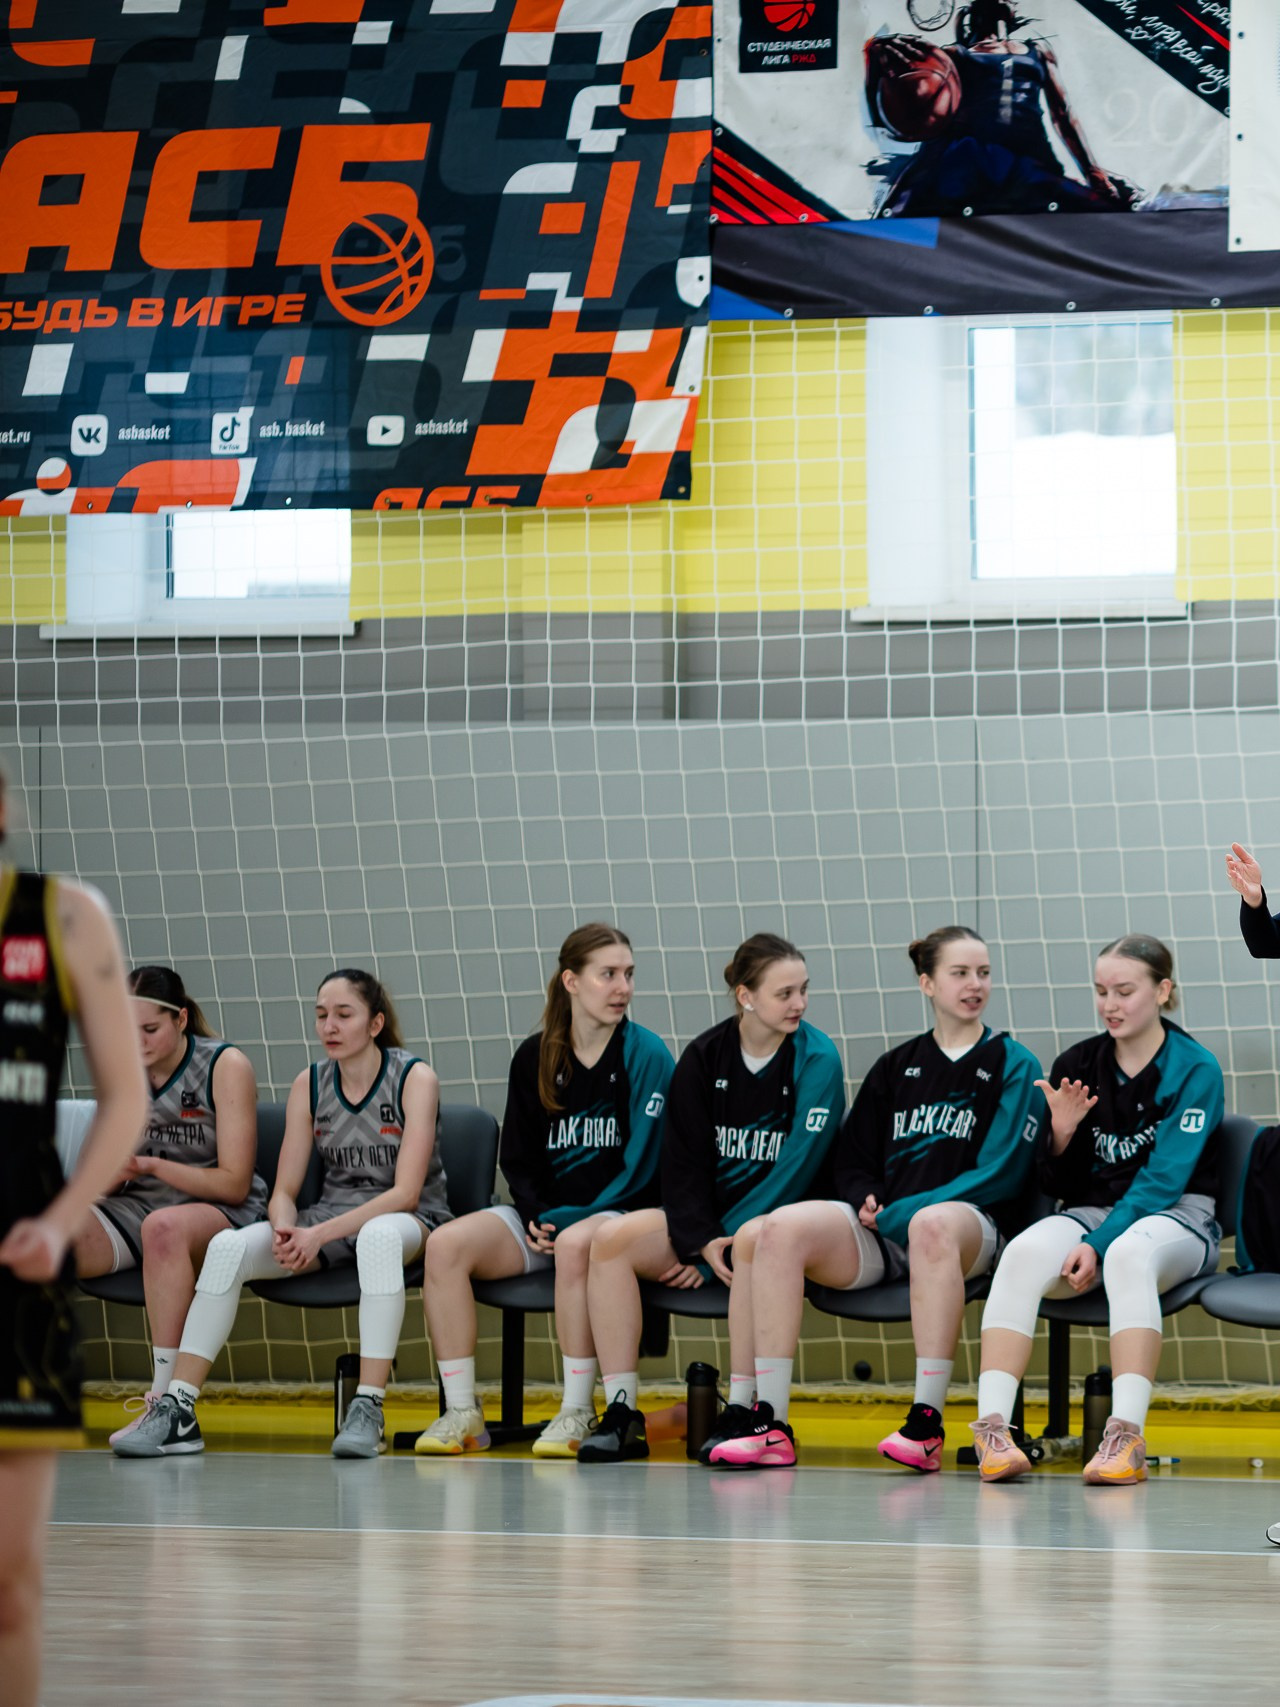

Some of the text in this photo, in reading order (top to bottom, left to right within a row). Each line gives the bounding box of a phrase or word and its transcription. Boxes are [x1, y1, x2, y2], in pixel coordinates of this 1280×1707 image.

[747, 38, 831, 53] СТУДЕНЧЕСКАЯ
[761, 53, 816, 65] ЛИГА РЖД
[0, 122, 433, 275] АСБ
[126, 298, 165, 328] В
[172, 293, 307, 328] ИГРЕ
[117, 423, 171, 441] asbasket
[414, 418, 469, 436] asbasket
[369, 1144, 401, 1167] ПЕТР
